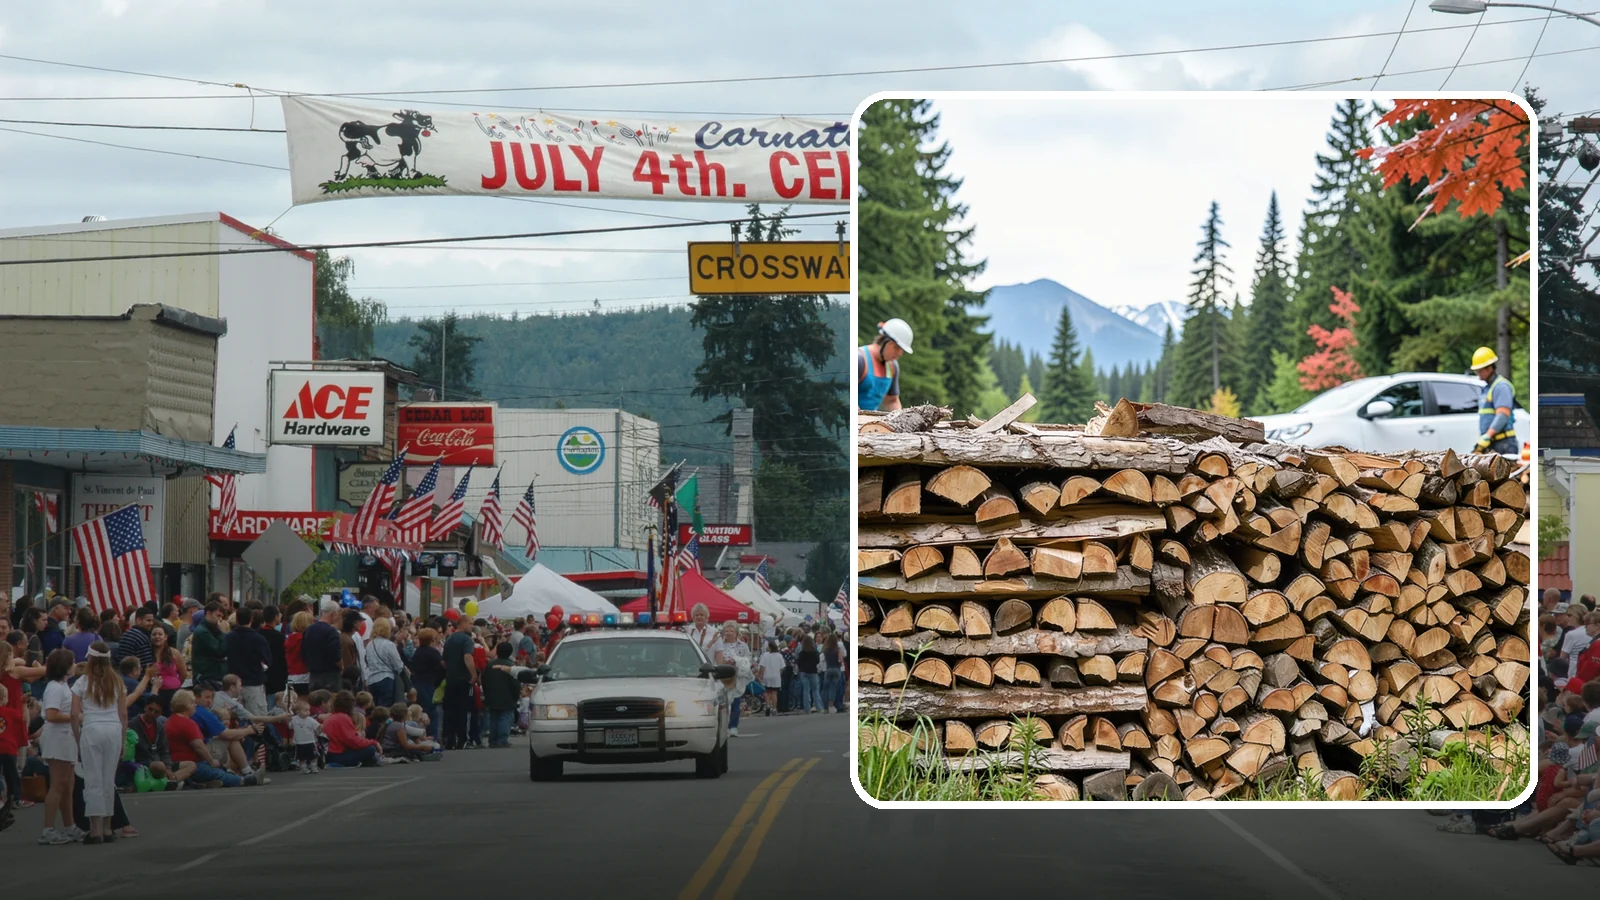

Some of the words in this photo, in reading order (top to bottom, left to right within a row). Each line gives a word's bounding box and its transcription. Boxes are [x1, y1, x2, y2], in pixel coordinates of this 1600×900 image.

[481, 141, 605, 193] JULY
[633, 150, 746, 198] 4th.
[697, 254, 850, 280] CROSSWA
[282, 380, 373, 420] ACE
[405, 409, 452, 422] CEDAR
[461, 409, 485, 422] LOG
[283, 421, 370, 437] Hardware
[353, 466, 386, 480] Simpl
[83, 484, 94, 494] St.
[95, 485, 124, 495] Vincent
[126, 485, 136, 495] de
[137, 485, 155, 496] Paul
[212, 516, 331, 535] HARDARE
[688, 526, 741, 535] CRNATION
[699, 535, 730, 544] GLASS
